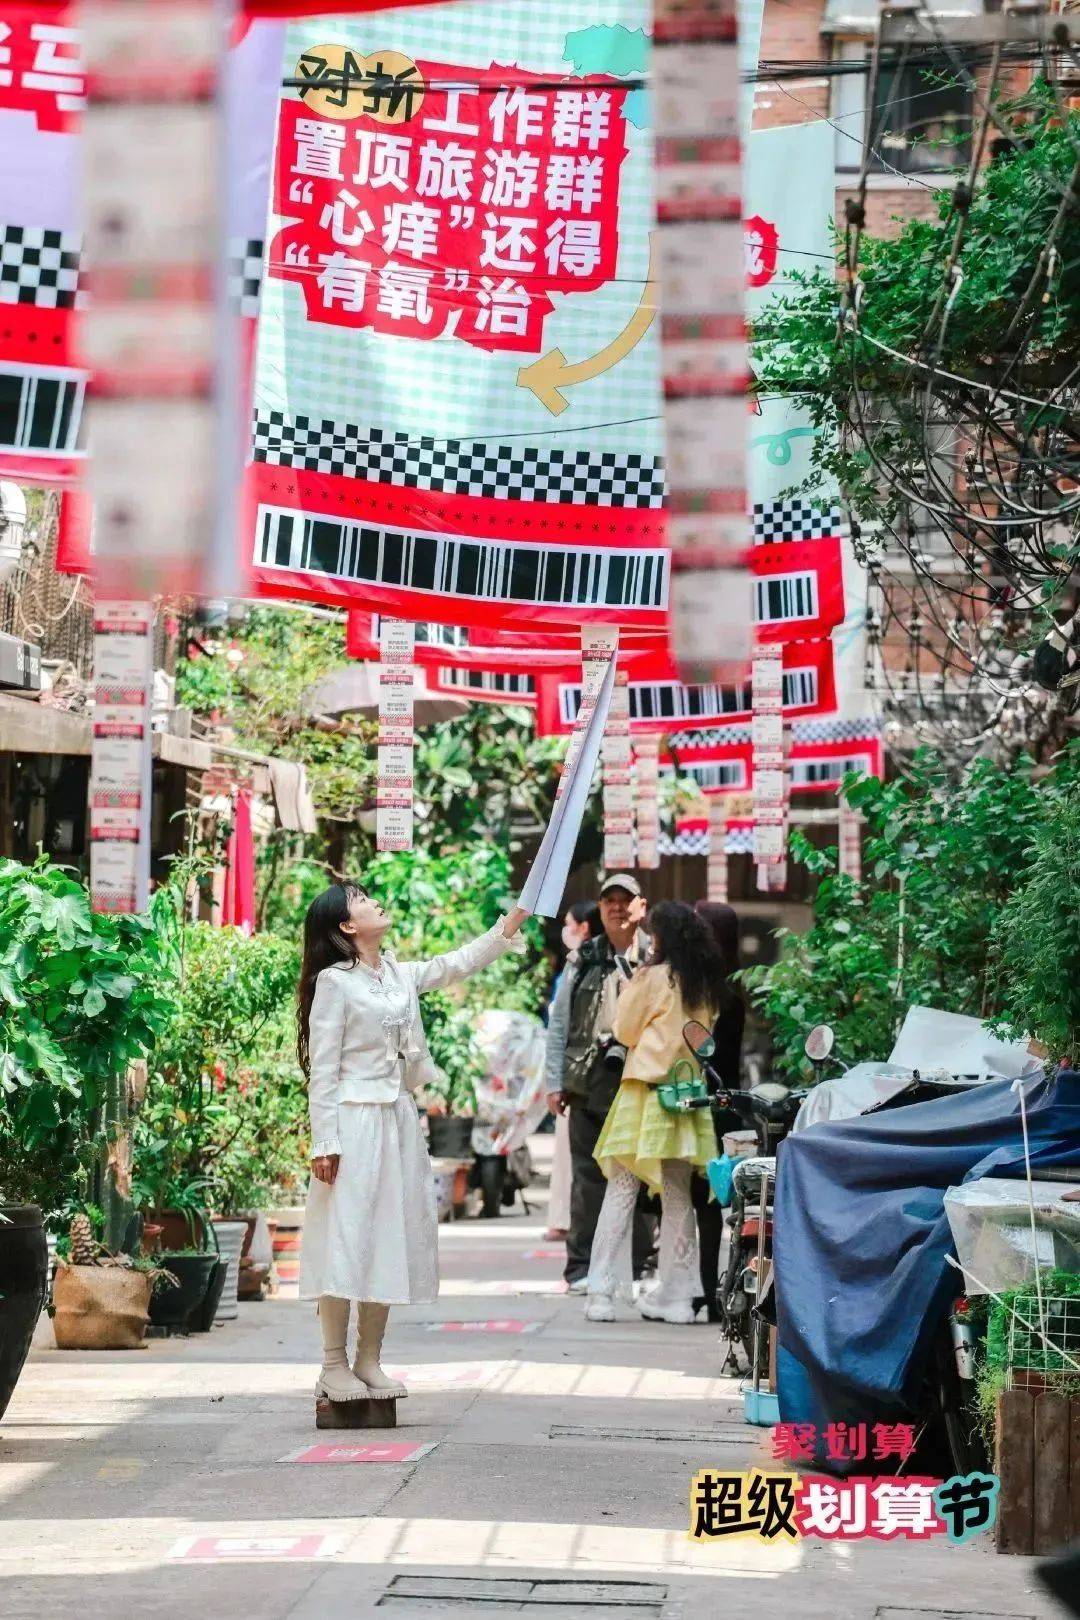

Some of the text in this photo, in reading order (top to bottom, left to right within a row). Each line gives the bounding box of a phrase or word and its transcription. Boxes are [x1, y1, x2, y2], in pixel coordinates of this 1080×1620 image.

[0, 20, 88, 112] 马
[422, 79, 611, 150] 工作群
[290, 118, 604, 214] 置顶旅游群
